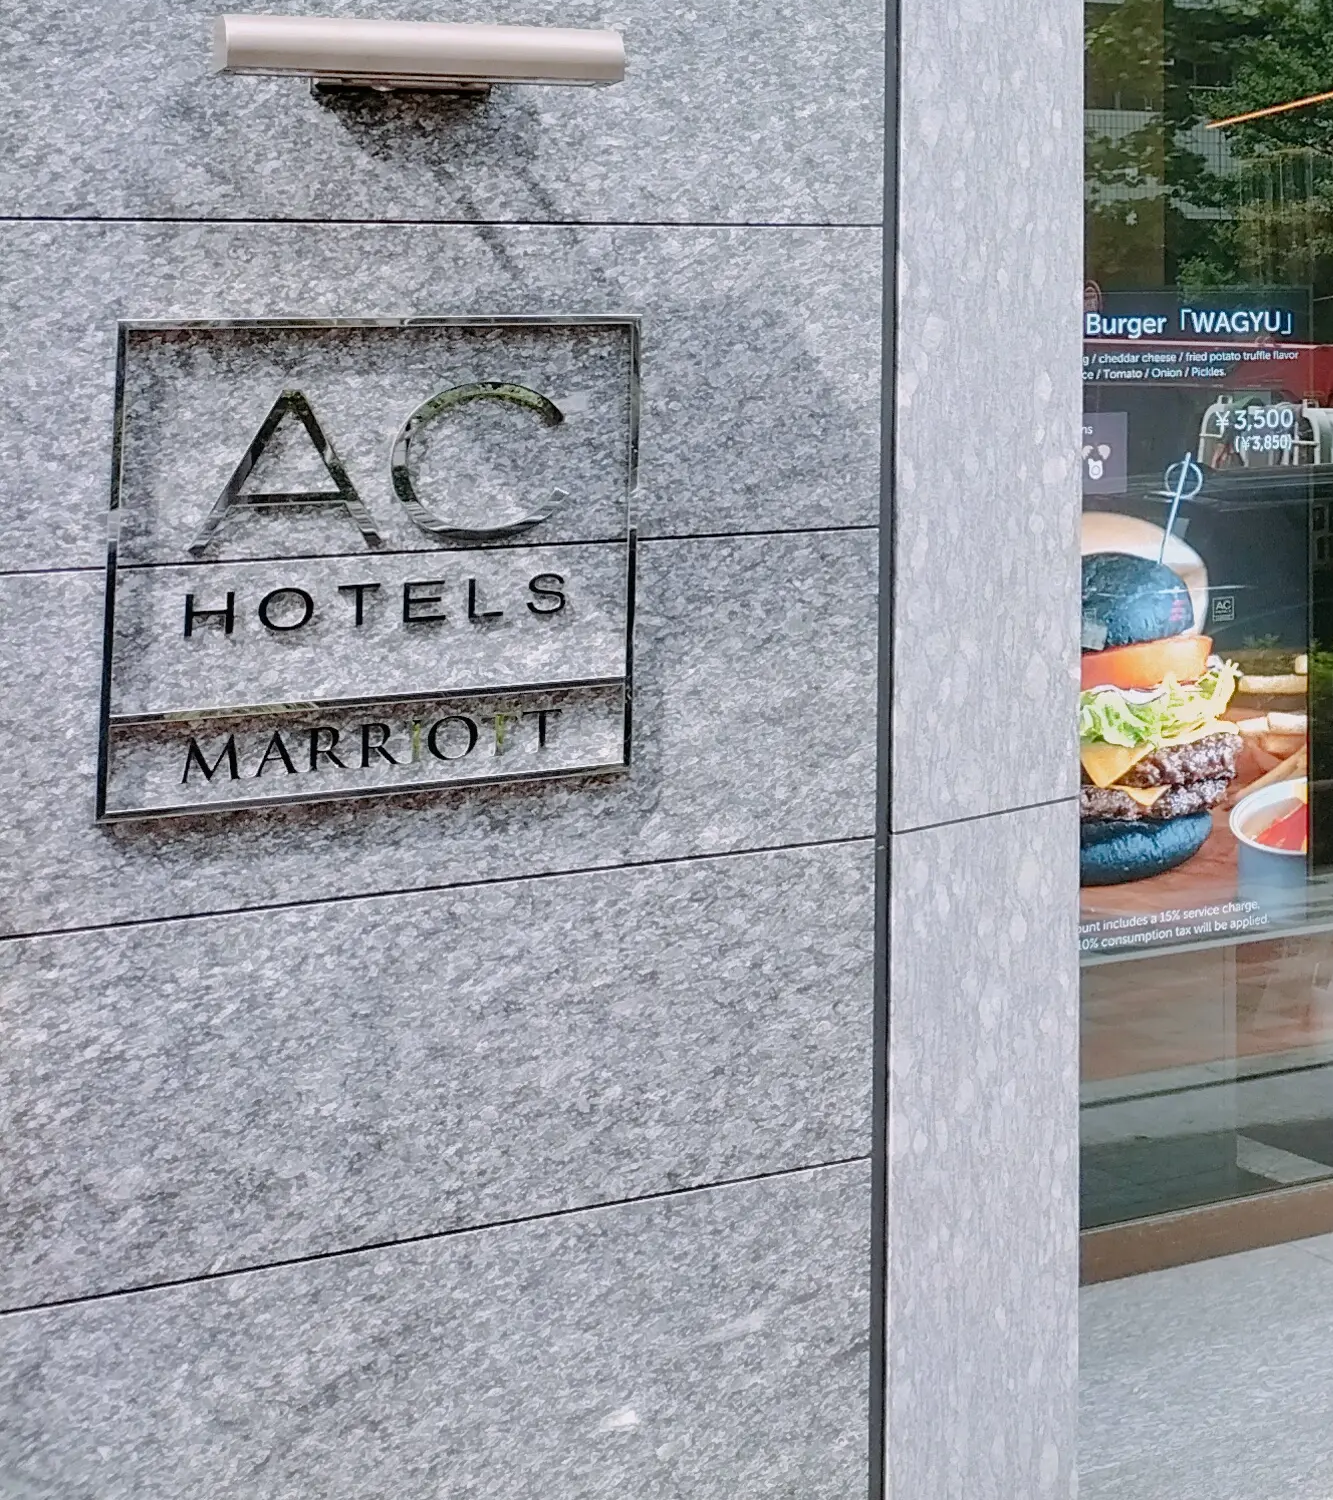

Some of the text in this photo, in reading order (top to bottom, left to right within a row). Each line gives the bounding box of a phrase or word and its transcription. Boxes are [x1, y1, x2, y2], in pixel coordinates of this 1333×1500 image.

[1086, 313, 1167, 339] Burger
[1098, 353, 1140, 364] cheddar
[1141, 353, 1177, 363] cheese
[1185, 352, 1207, 361] fried
[1209, 352, 1241, 363] potato
[1243, 351, 1271, 361] truffle
[1273, 350, 1299, 360] flavor
[1103, 369, 1143, 379] Tomato
[1151, 368, 1182, 378] Onion
[188, 381, 568, 554] AC
[183, 573, 567, 637] HOTELS
[180, 708, 563, 785] MARRIOTT
[1101, 928, 1173, 947] consumption
[1175, 926, 1192, 937] tax
[1193, 922, 1212, 934] will
[1214, 920, 1227, 931] be
[1229, 913, 1270, 930] applied.
[1102, 916, 1149, 930] includes
[1150, 915, 1157, 924] a
[1160, 909, 1181, 923] 15%
[1183, 905, 1220, 919] service
